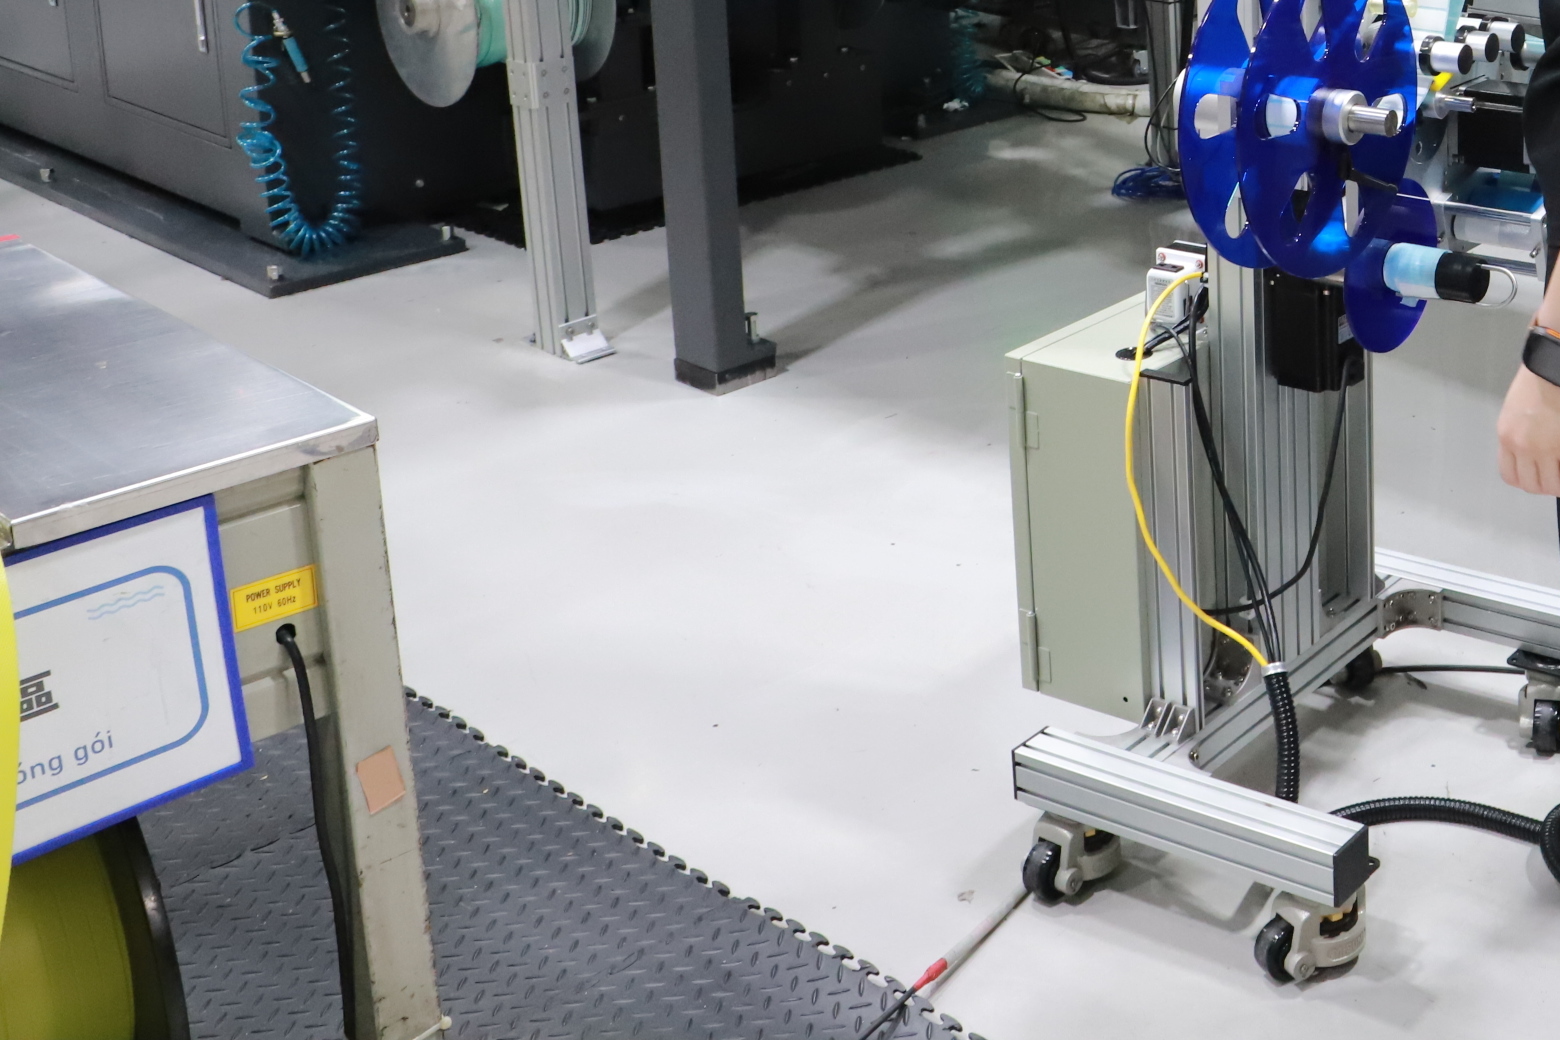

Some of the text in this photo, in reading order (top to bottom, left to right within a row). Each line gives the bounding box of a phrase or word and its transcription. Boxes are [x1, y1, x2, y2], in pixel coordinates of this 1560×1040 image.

[246, 578, 301, 603] POWER SUPPLY
[253, 595, 296, 615] 110V 60Hz
[17, 730, 113, 785] óng gói
